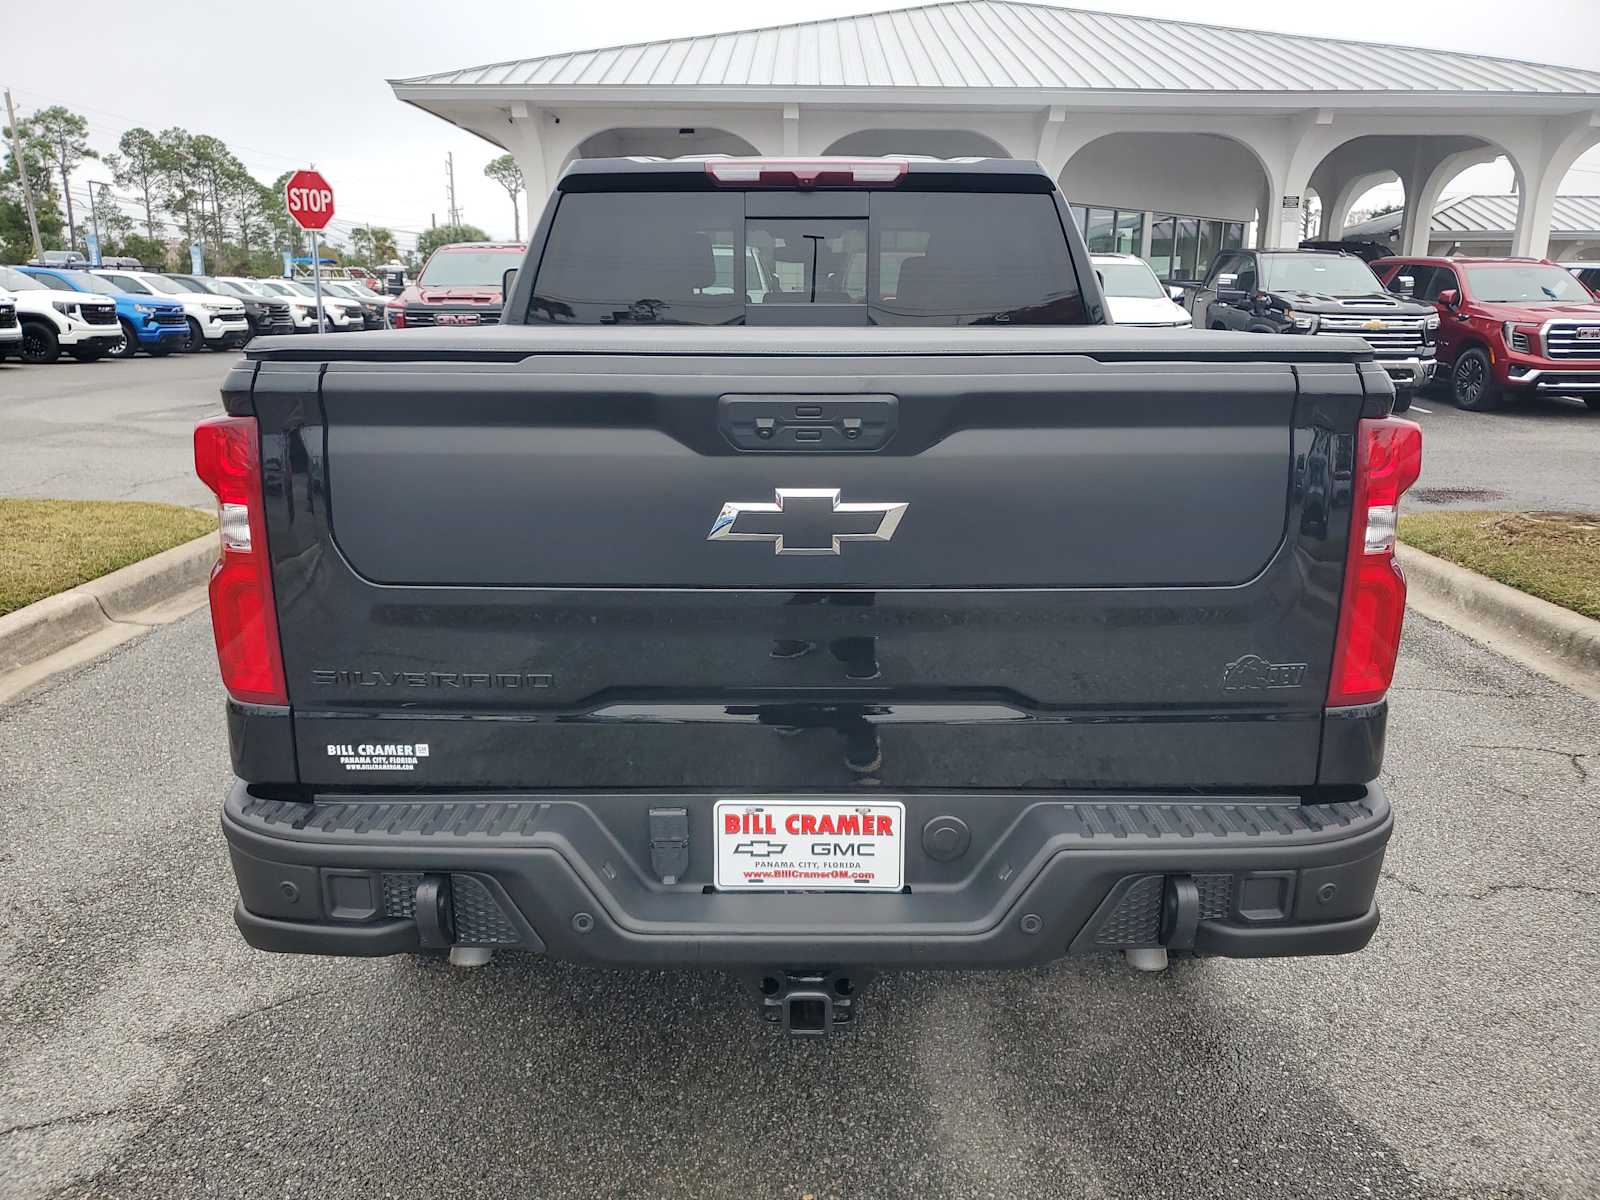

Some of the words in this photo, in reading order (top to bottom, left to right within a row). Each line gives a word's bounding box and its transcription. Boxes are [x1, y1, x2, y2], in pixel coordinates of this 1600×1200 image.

[289, 188, 331, 212] STOP
[437, 315, 477, 325] GMC
[312, 670, 554, 689] SILVERADO
[327, 745, 354, 756] BILL
[358, 745, 413, 756] CRAMER
[725, 814, 777, 835] BILL
[785, 814, 894, 836] CRAMER
[811, 843, 874, 856] GMC
[743, 870, 875, 879] www.BillCramerGM.com
